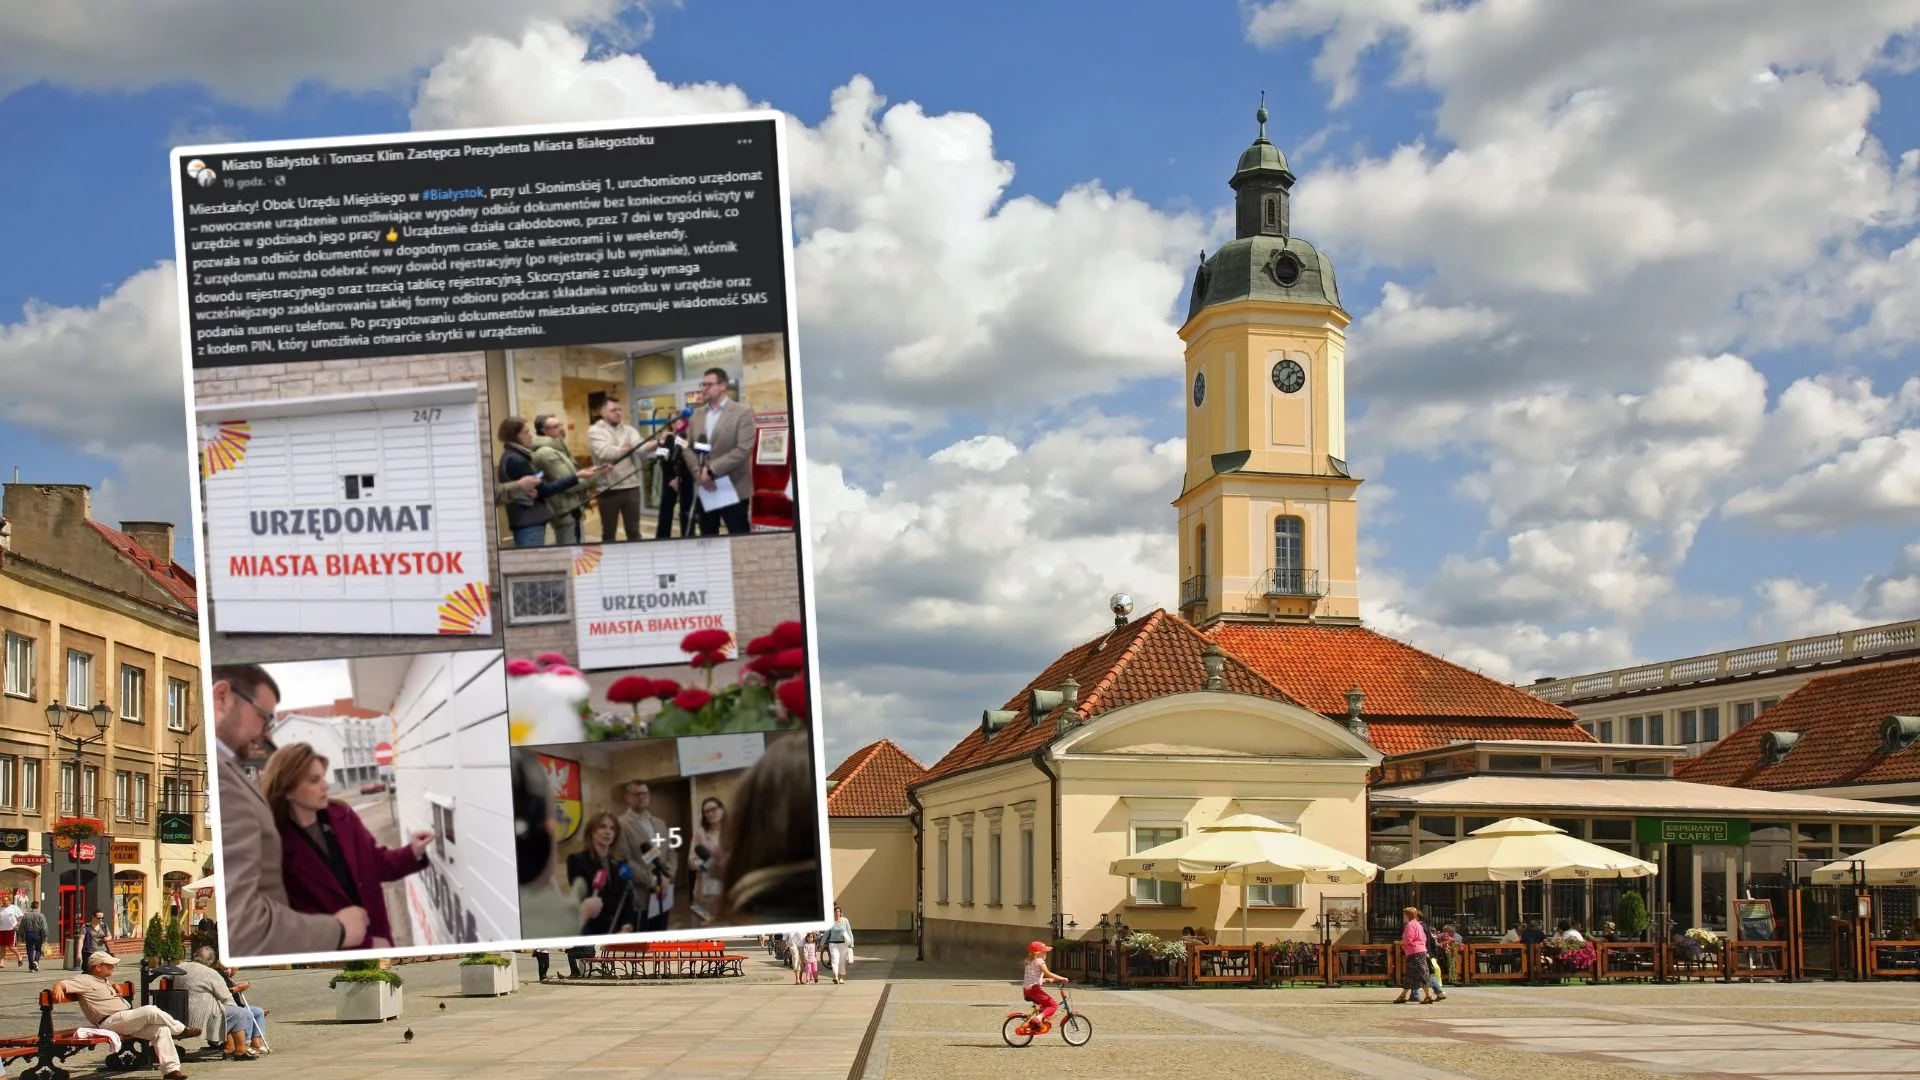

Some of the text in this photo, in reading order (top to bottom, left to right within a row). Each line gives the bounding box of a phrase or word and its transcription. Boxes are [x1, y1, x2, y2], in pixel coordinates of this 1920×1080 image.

[412, 409, 442, 422] 24/7
[250, 504, 432, 541] URZĘDOMAT
[230, 551, 464, 577] MIASTA BIAŁYSTOK
[602, 590, 707, 613] URZĘDOMAT
[589, 614, 724, 636] MIASTA BIAŁYSTOK
[1666, 824, 1724, 832] ESPERANTO
[1678, 832, 1711, 840] CAFE
